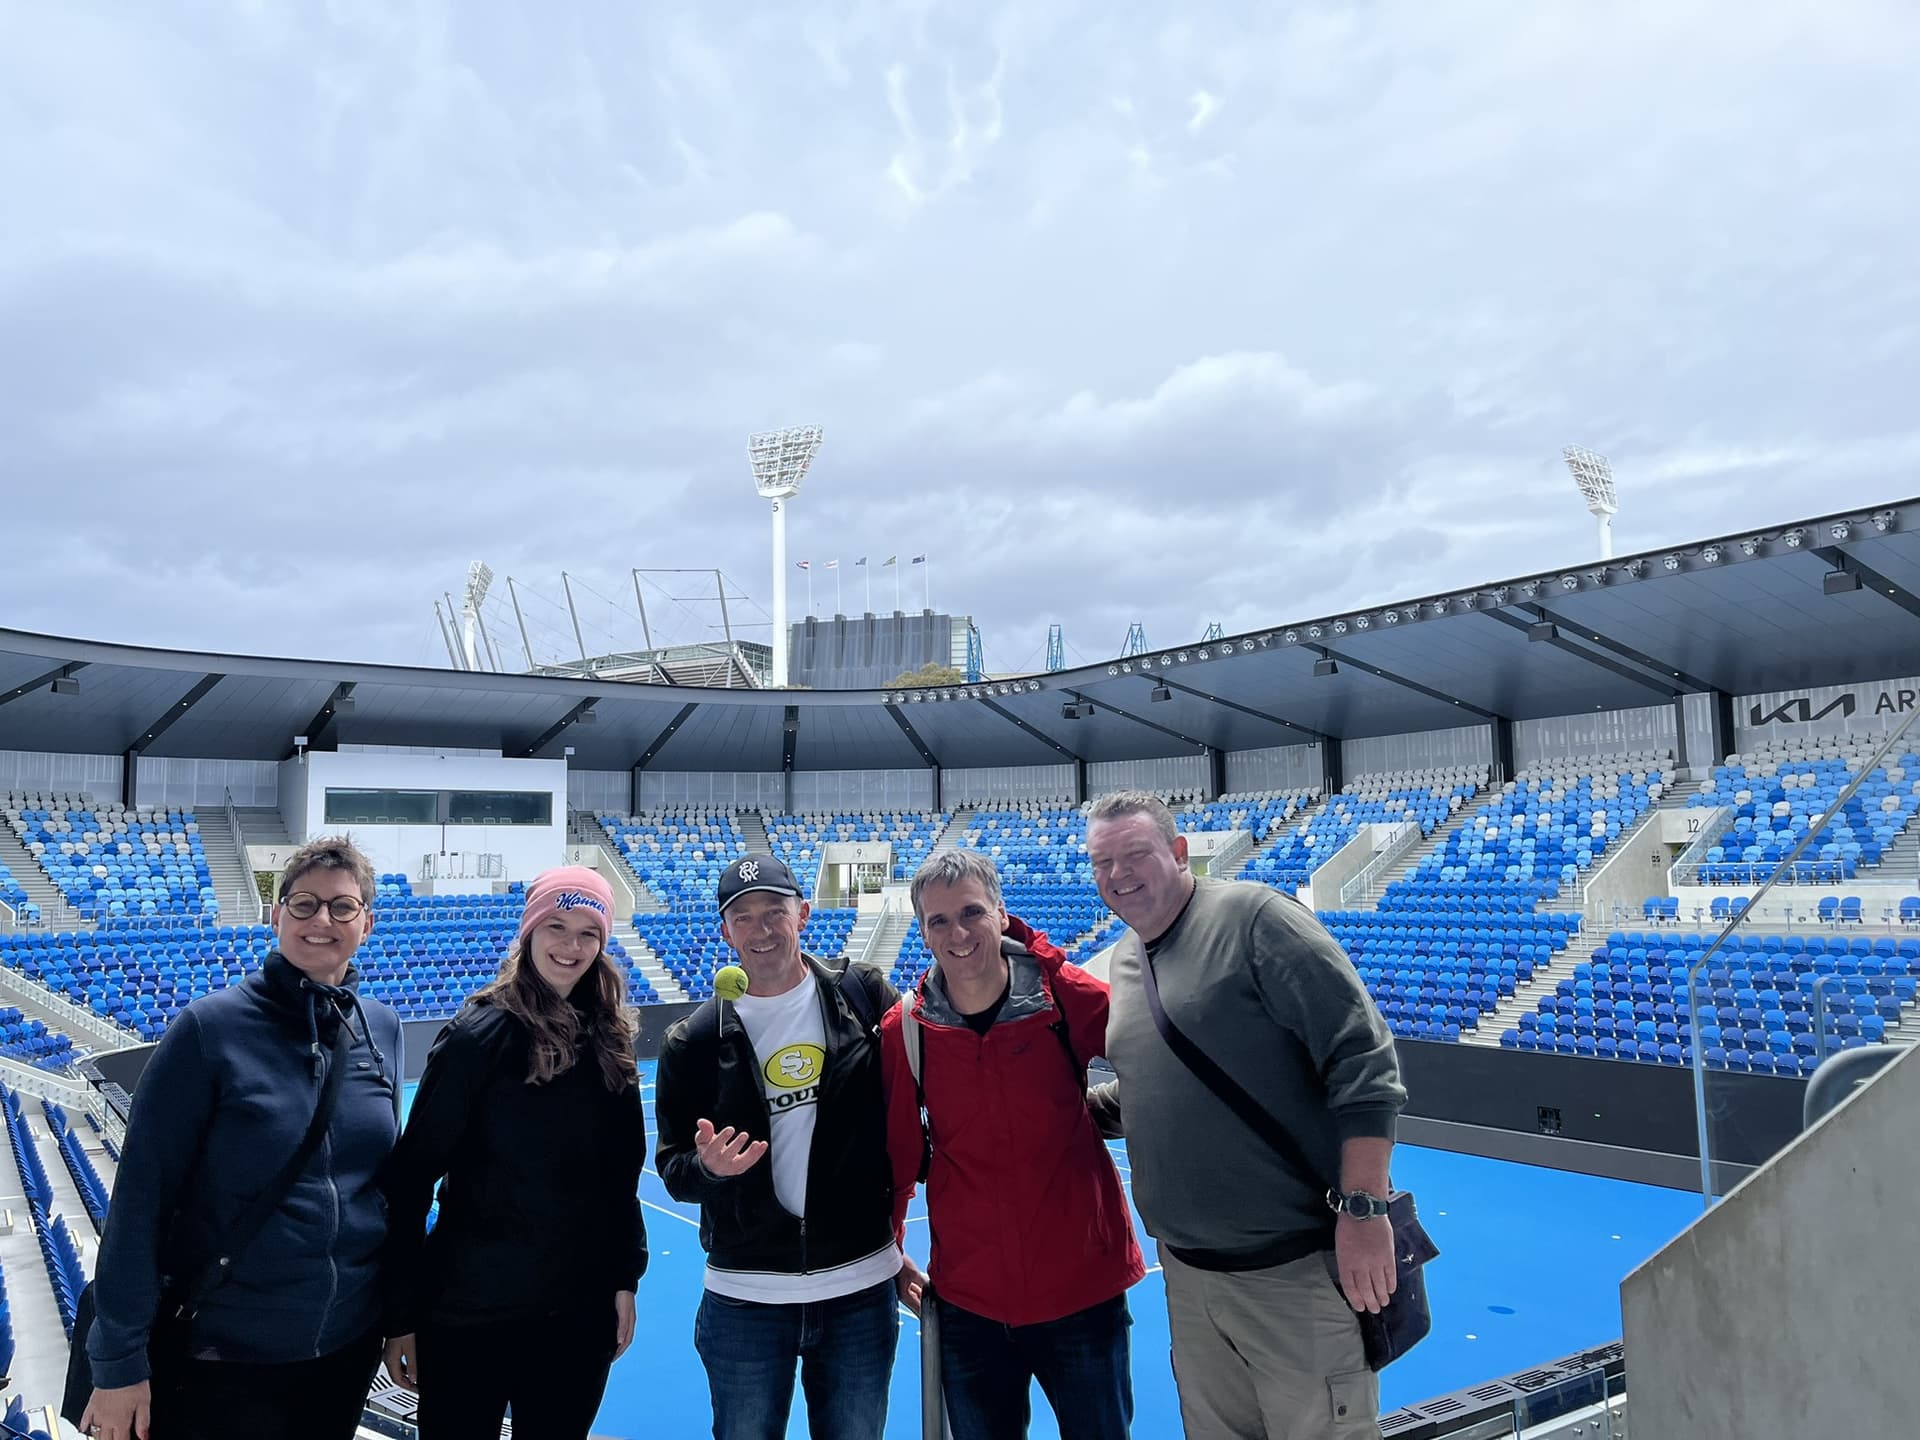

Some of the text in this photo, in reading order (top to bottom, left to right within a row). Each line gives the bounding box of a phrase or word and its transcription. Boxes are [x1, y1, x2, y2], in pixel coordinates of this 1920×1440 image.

[772, 502, 779, 512] 5
[1750, 688, 1920, 727] KIA AR
[1687, 818, 1700, 833] 12
[1388, 831, 1397, 844] 11
[1207, 838, 1215, 850] 10
[270, 853, 277, 864] 7
[574, 851, 580, 861] 8
[856, 848, 863, 858] 9
[779, 1050, 814, 1081] SC
